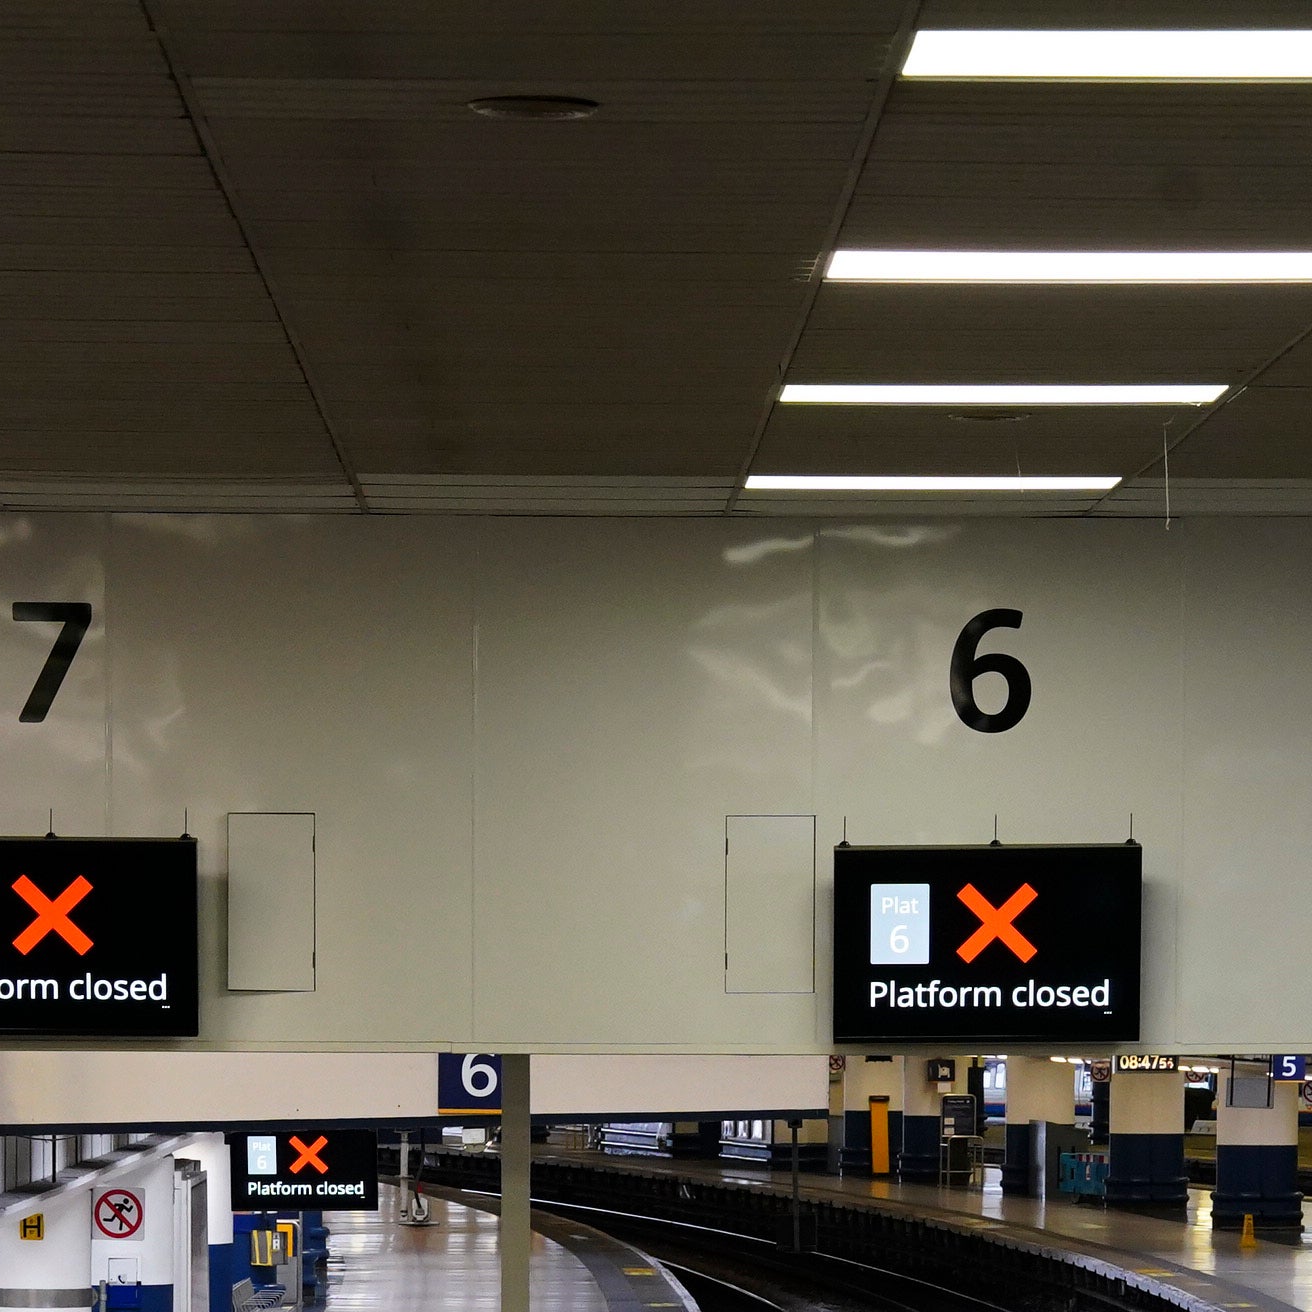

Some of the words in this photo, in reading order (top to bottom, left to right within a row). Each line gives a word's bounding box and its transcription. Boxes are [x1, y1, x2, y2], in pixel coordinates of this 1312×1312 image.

[12, 601, 92, 723] 7
[950, 608, 1032, 734] 6
[881, 896, 919, 915] Plat
[889, 925, 910, 954] 6
[69, 972, 167, 1001] closed
[870, 979, 1002, 1008] Platform
[1011, 978, 1110, 1008] closed
[461, 1053, 499, 1098] 6
[1281, 1054, 1297, 1078] 5
[252, 1141, 272, 1152] Plat
[256, 1155, 267, 1170] 6
[247, 1181, 313, 1196] Platform
[316, 1180, 365, 1196] closed
